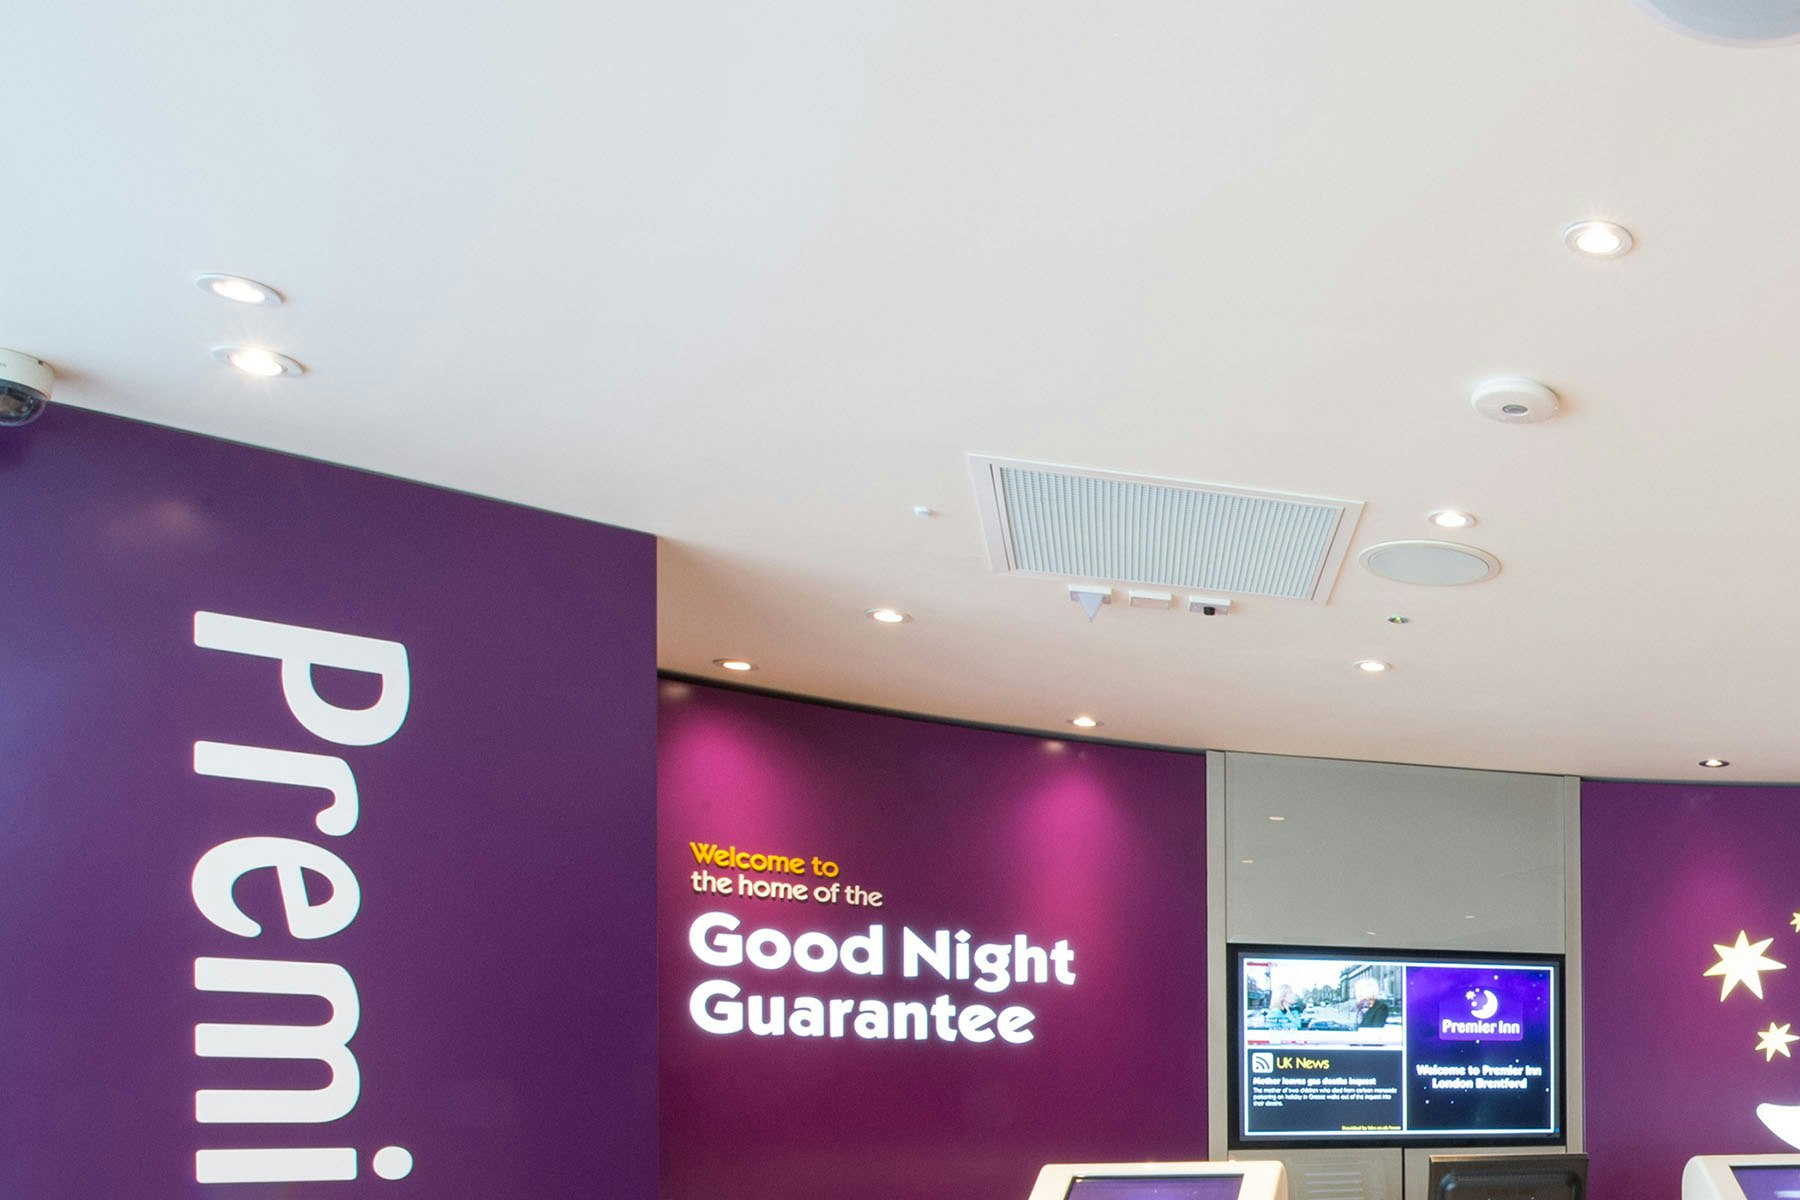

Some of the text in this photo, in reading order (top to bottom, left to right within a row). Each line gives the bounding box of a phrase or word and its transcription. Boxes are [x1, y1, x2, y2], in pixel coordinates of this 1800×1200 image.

[689, 841, 839, 878] Welcome to
[691, 870, 884, 907] the home of the
[688, 911, 1077, 993] Good Night
[688, 979, 1036, 1044] Guarantee
[1442, 1019, 1520, 1034] Premier Inn
[1276, 1057, 1330, 1069] UK News
[1416, 1064, 1542, 1076] Welcome to Premier Inn
[1432, 1077, 1528, 1089] London Brentford
